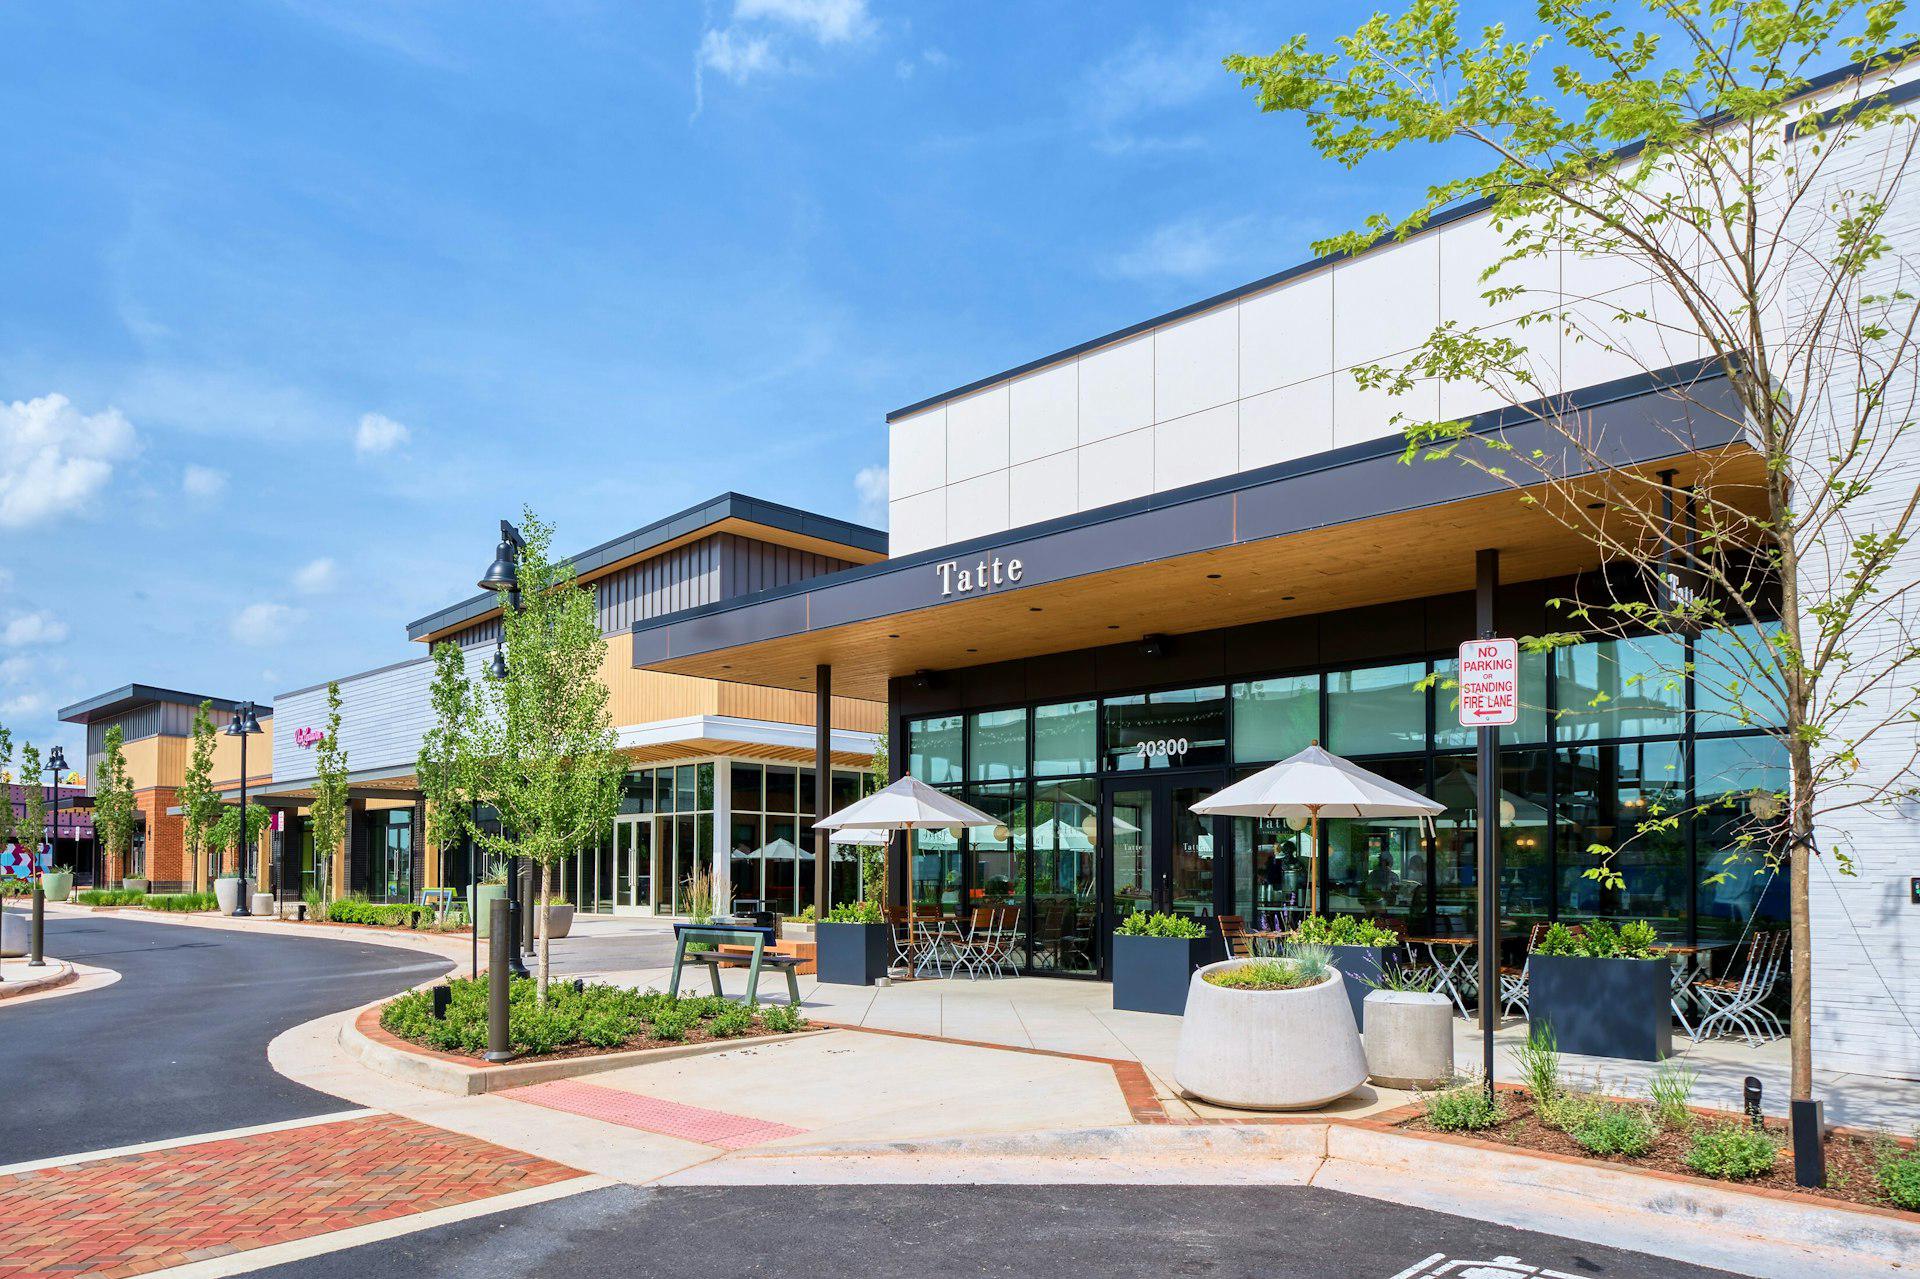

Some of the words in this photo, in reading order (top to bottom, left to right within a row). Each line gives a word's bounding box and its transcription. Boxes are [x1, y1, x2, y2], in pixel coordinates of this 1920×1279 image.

[937, 558, 1022, 595] Tatte
[1668, 574, 1700, 607] Tatt
[1478, 647, 1497, 658] NO
[1464, 659, 1512, 672] PARKING
[1464, 681, 1512, 694] STANDING
[1464, 696, 1484, 709] FIRE
[1487, 695, 1512, 708] LANE
[1137, 738, 1188, 758] 20300
